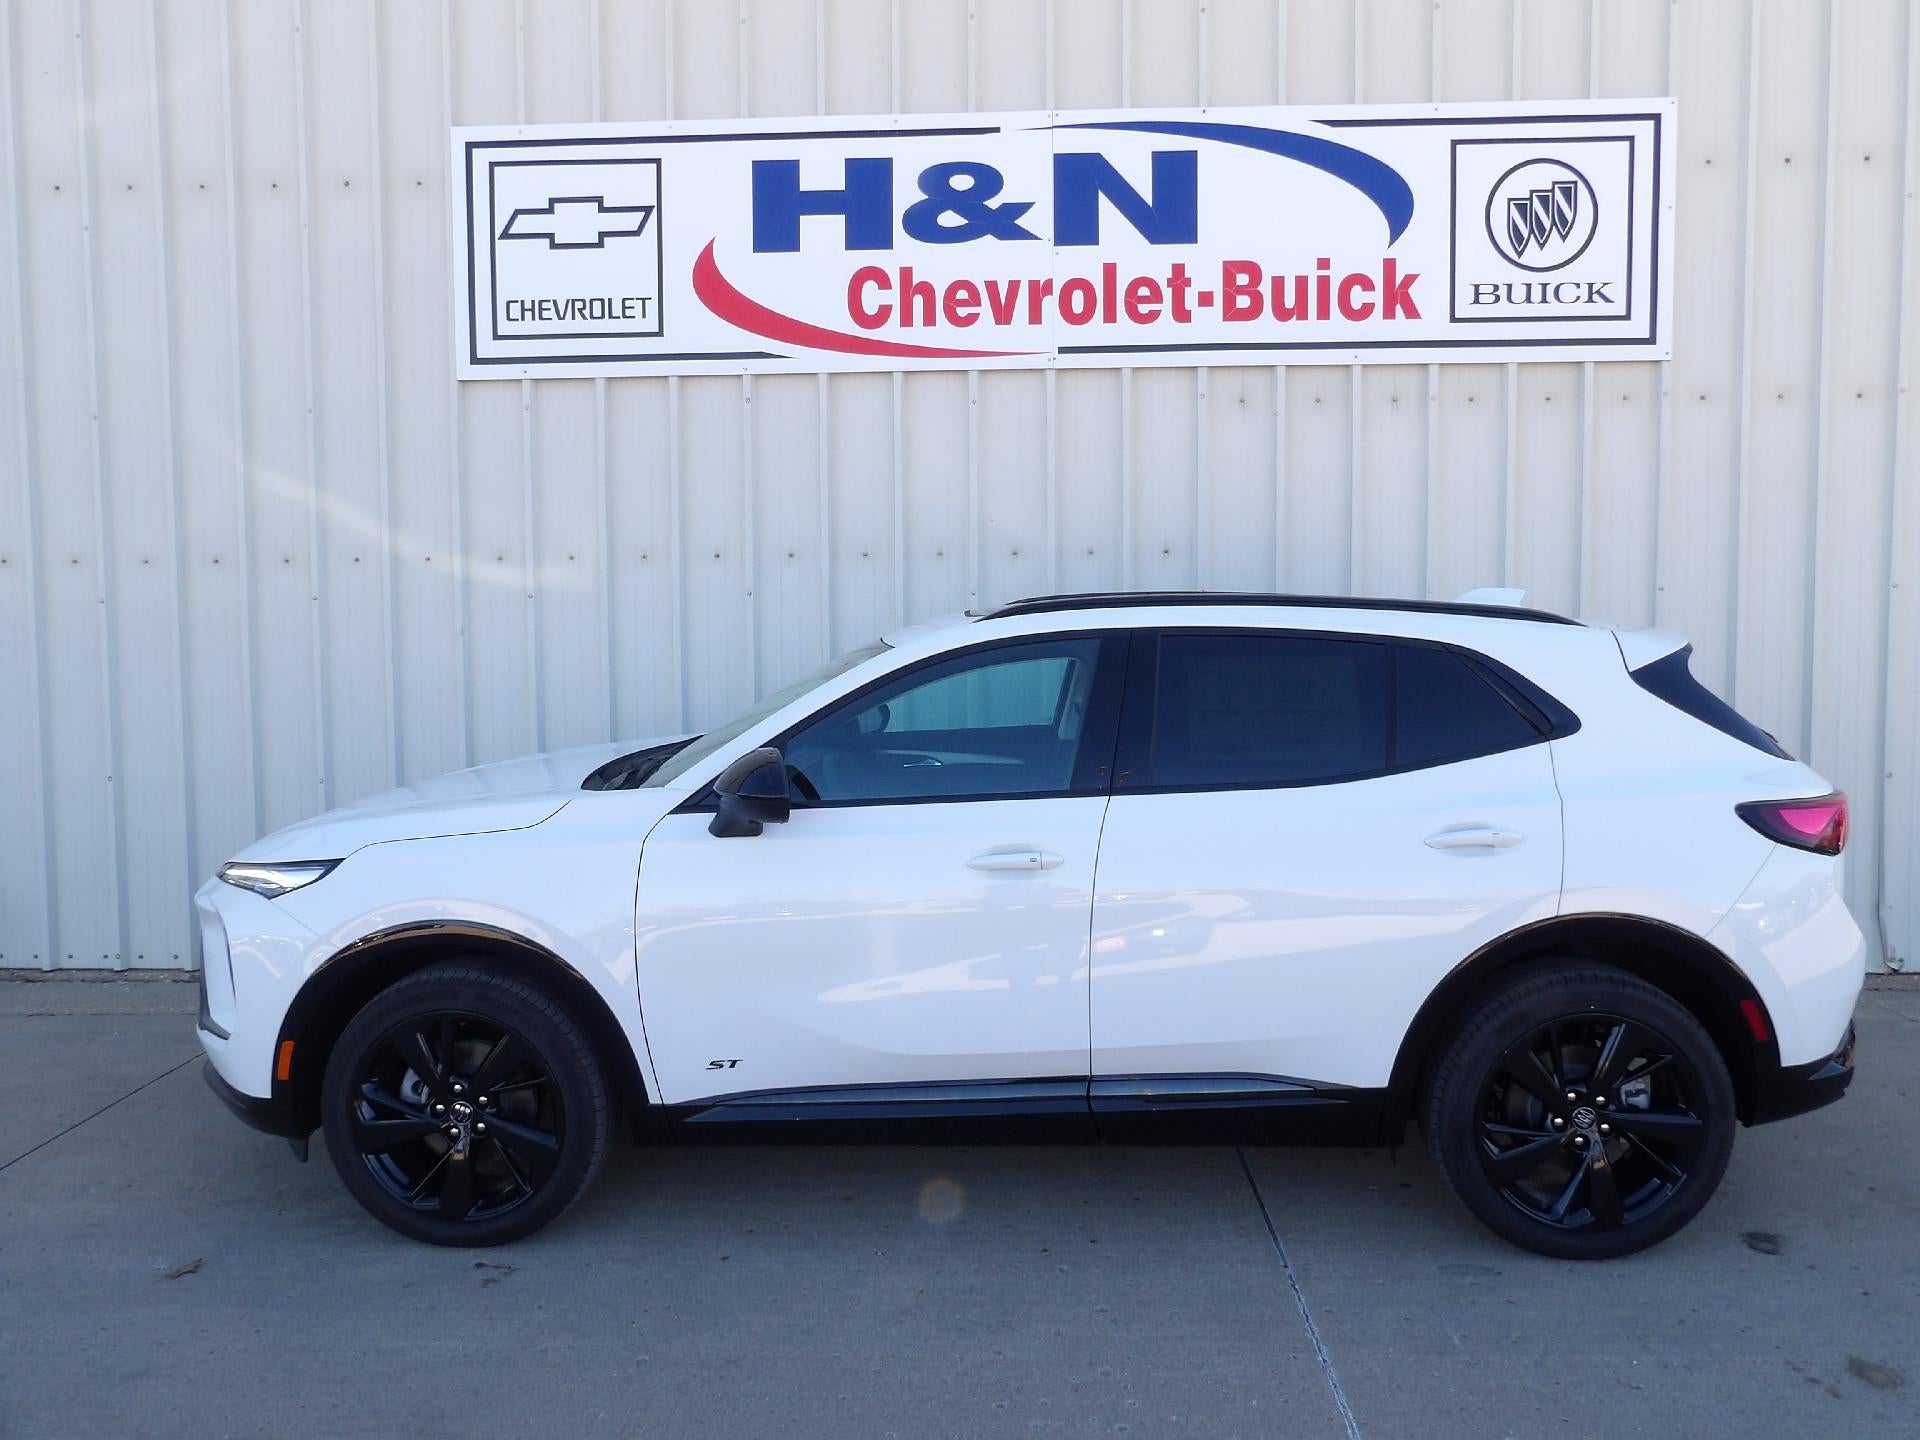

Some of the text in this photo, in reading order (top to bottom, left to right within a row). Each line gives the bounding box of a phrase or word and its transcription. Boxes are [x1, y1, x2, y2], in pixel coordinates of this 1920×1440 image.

[751, 149, 1198, 253] H&N
[846, 257, 1422, 330] Chevrolet-Buick
[1469, 281, 1616, 306] BUICK
[505, 296, 653, 322] CHEVROLET
[705, 1059, 744, 1070] ST
